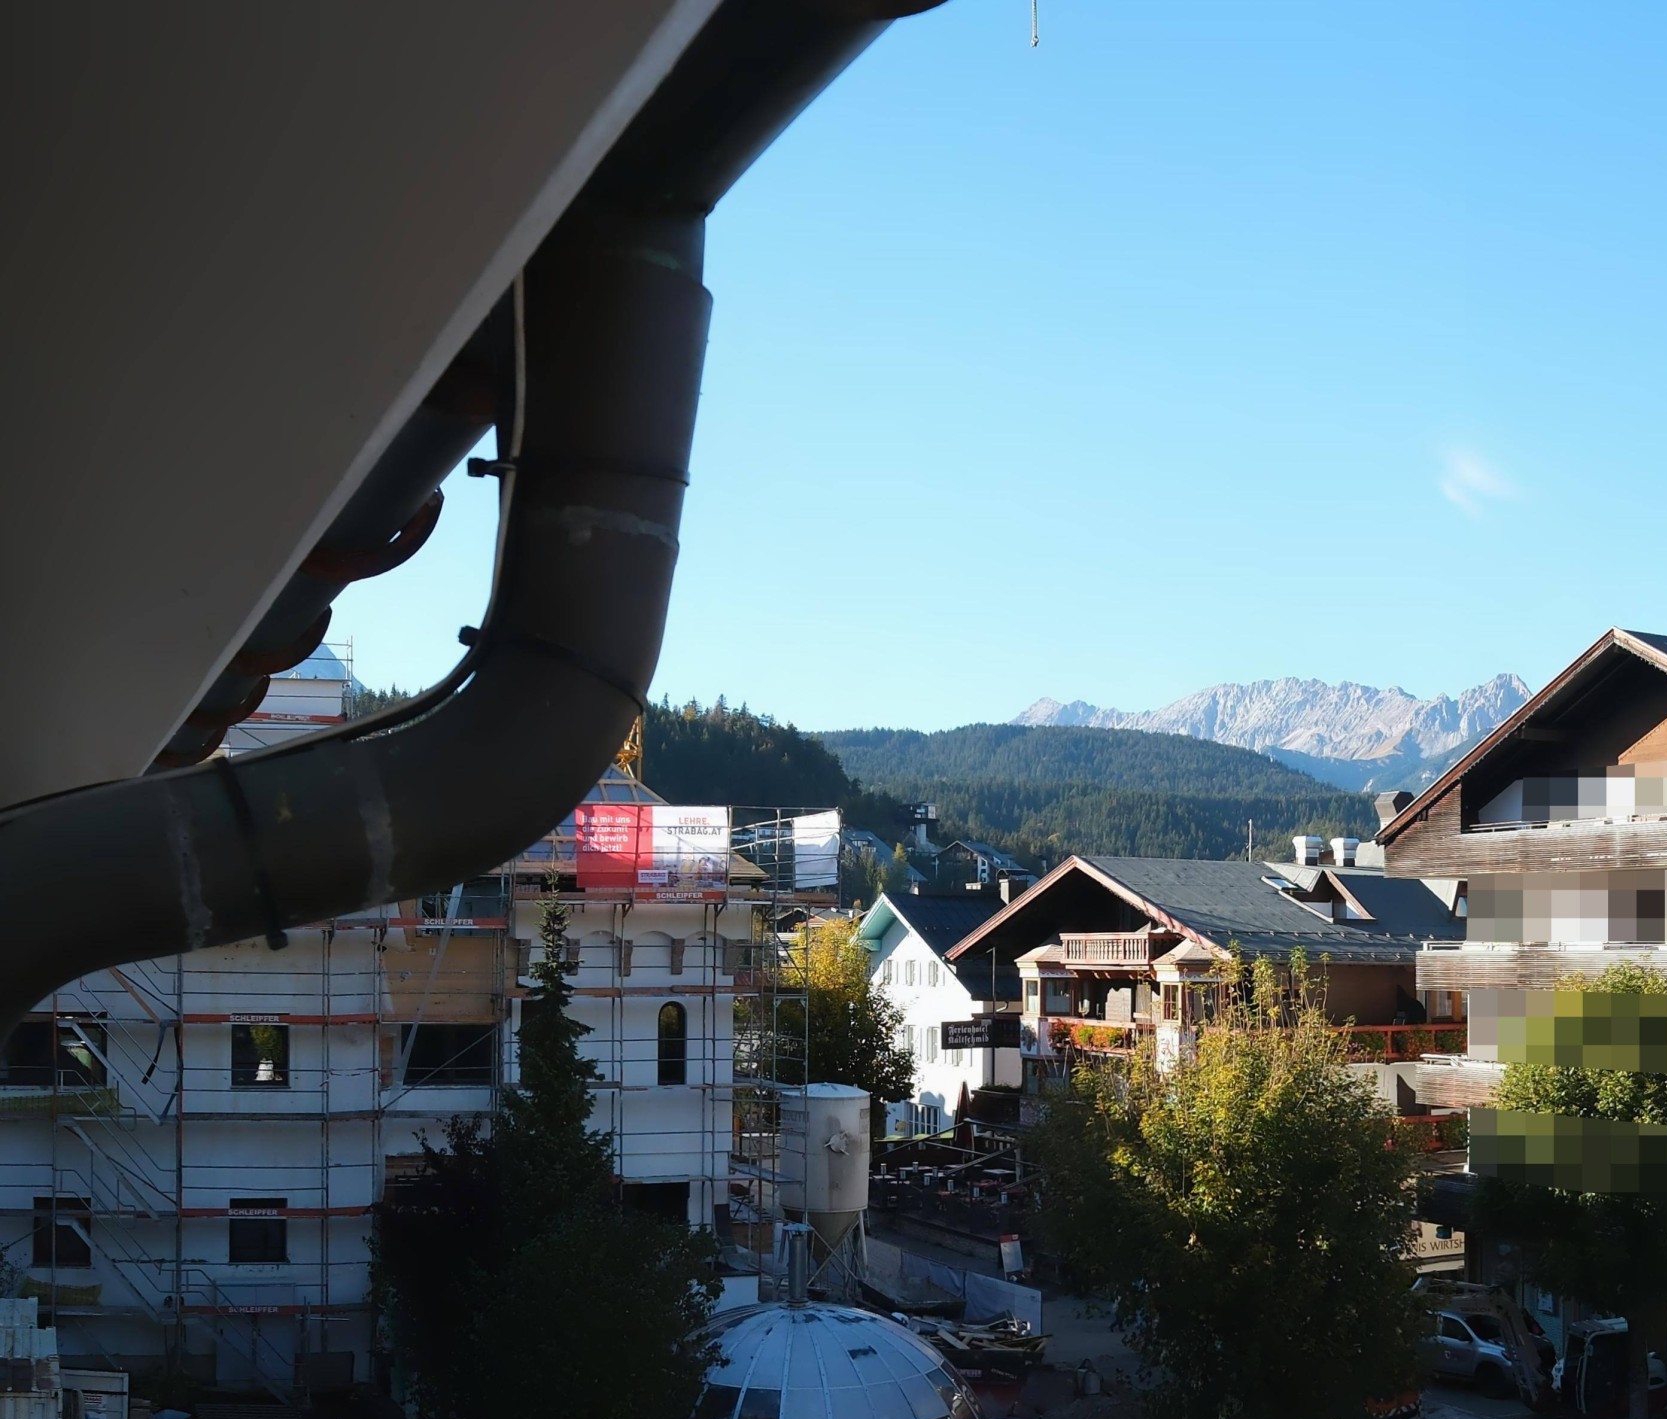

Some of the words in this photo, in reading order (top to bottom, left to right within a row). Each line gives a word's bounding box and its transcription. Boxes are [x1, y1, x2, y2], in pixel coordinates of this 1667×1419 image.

[600, 815, 613, 823] mit
[679, 817, 710, 826] LEHRE.
[667, 827, 722, 836] STRABAG.AT
[600, 834, 629, 842] bewirb
